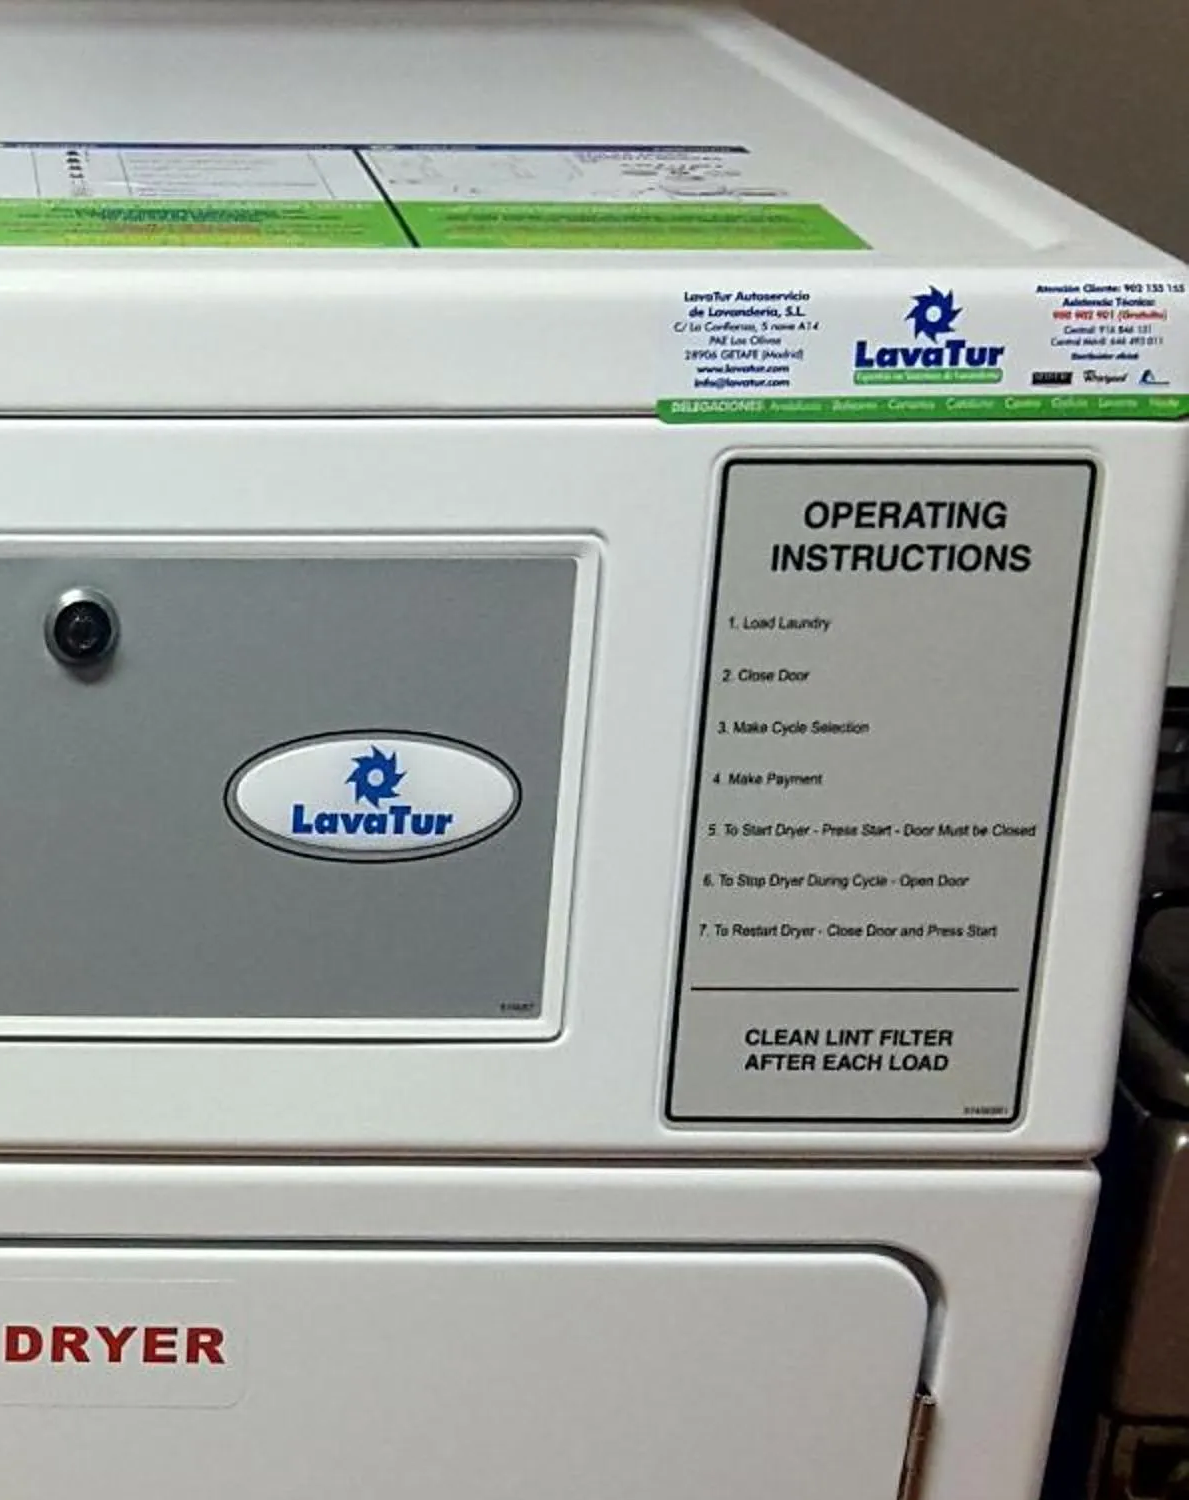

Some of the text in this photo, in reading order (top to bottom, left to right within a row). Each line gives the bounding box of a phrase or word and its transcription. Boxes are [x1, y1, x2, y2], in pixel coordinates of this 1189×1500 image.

[684, 291, 810, 302] LavaTur Autoservicio
[689, 307, 704, 317] de
[855, 339, 1005, 368] LavaTur
[804, 500, 1008, 529] OPERATING
[770, 543, 1032, 573] INSTRUCTIONS
[728, 616, 831, 632] 1. Load Laundry
[738, 669, 775, 682] Close
[778, 669, 810, 682] Door
[717, 721, 869, 736] 3. Make Cycle Selection
[728, 773, 763, 786] Make
[766, 773, 823, 788] Payment
[292, 804, 454, 836] LavaTur
[724, 824, 738, 836] To
[743, 824, 772, 837] Start
[775, 824, 810, 839] Dryer
[821, 824, 858, 837] Press
[862, 824, 892, 836] Start
[904, 824, 934, 836] Door
[938, 824, 970, 836] Must
[972, 824, 988, 837] be
[992, 824, 1036, 837] Closed
[719, 874, 734, 887] To
[737, 874, 766, 889] Stop
[769, 874, 805, 889] Dryer
[807, 874, 849, 889] During
[852, 874, 887, 889] Cycle
[900, 874, 934, 889] Open
[937, 874, 969, 887] Door
[715, 924, 729, 937] To
[732, 924, 778, 937] Restart
[781, 924, 815, 939] Dryer
[827, 924, 862, 937] Close
[866, 924, 897, 937] Door
[900, 924, 924, 937] and
[927, 924, 963, 937] Press
[967, 924, 997, 937] Start
[744, 1029, 954, 1047] CLEAN LINT FILTER
[744, 1054, 949, 1071] AFTER EACH LOAD
[3, 1323, 226, 1365] DRYER
